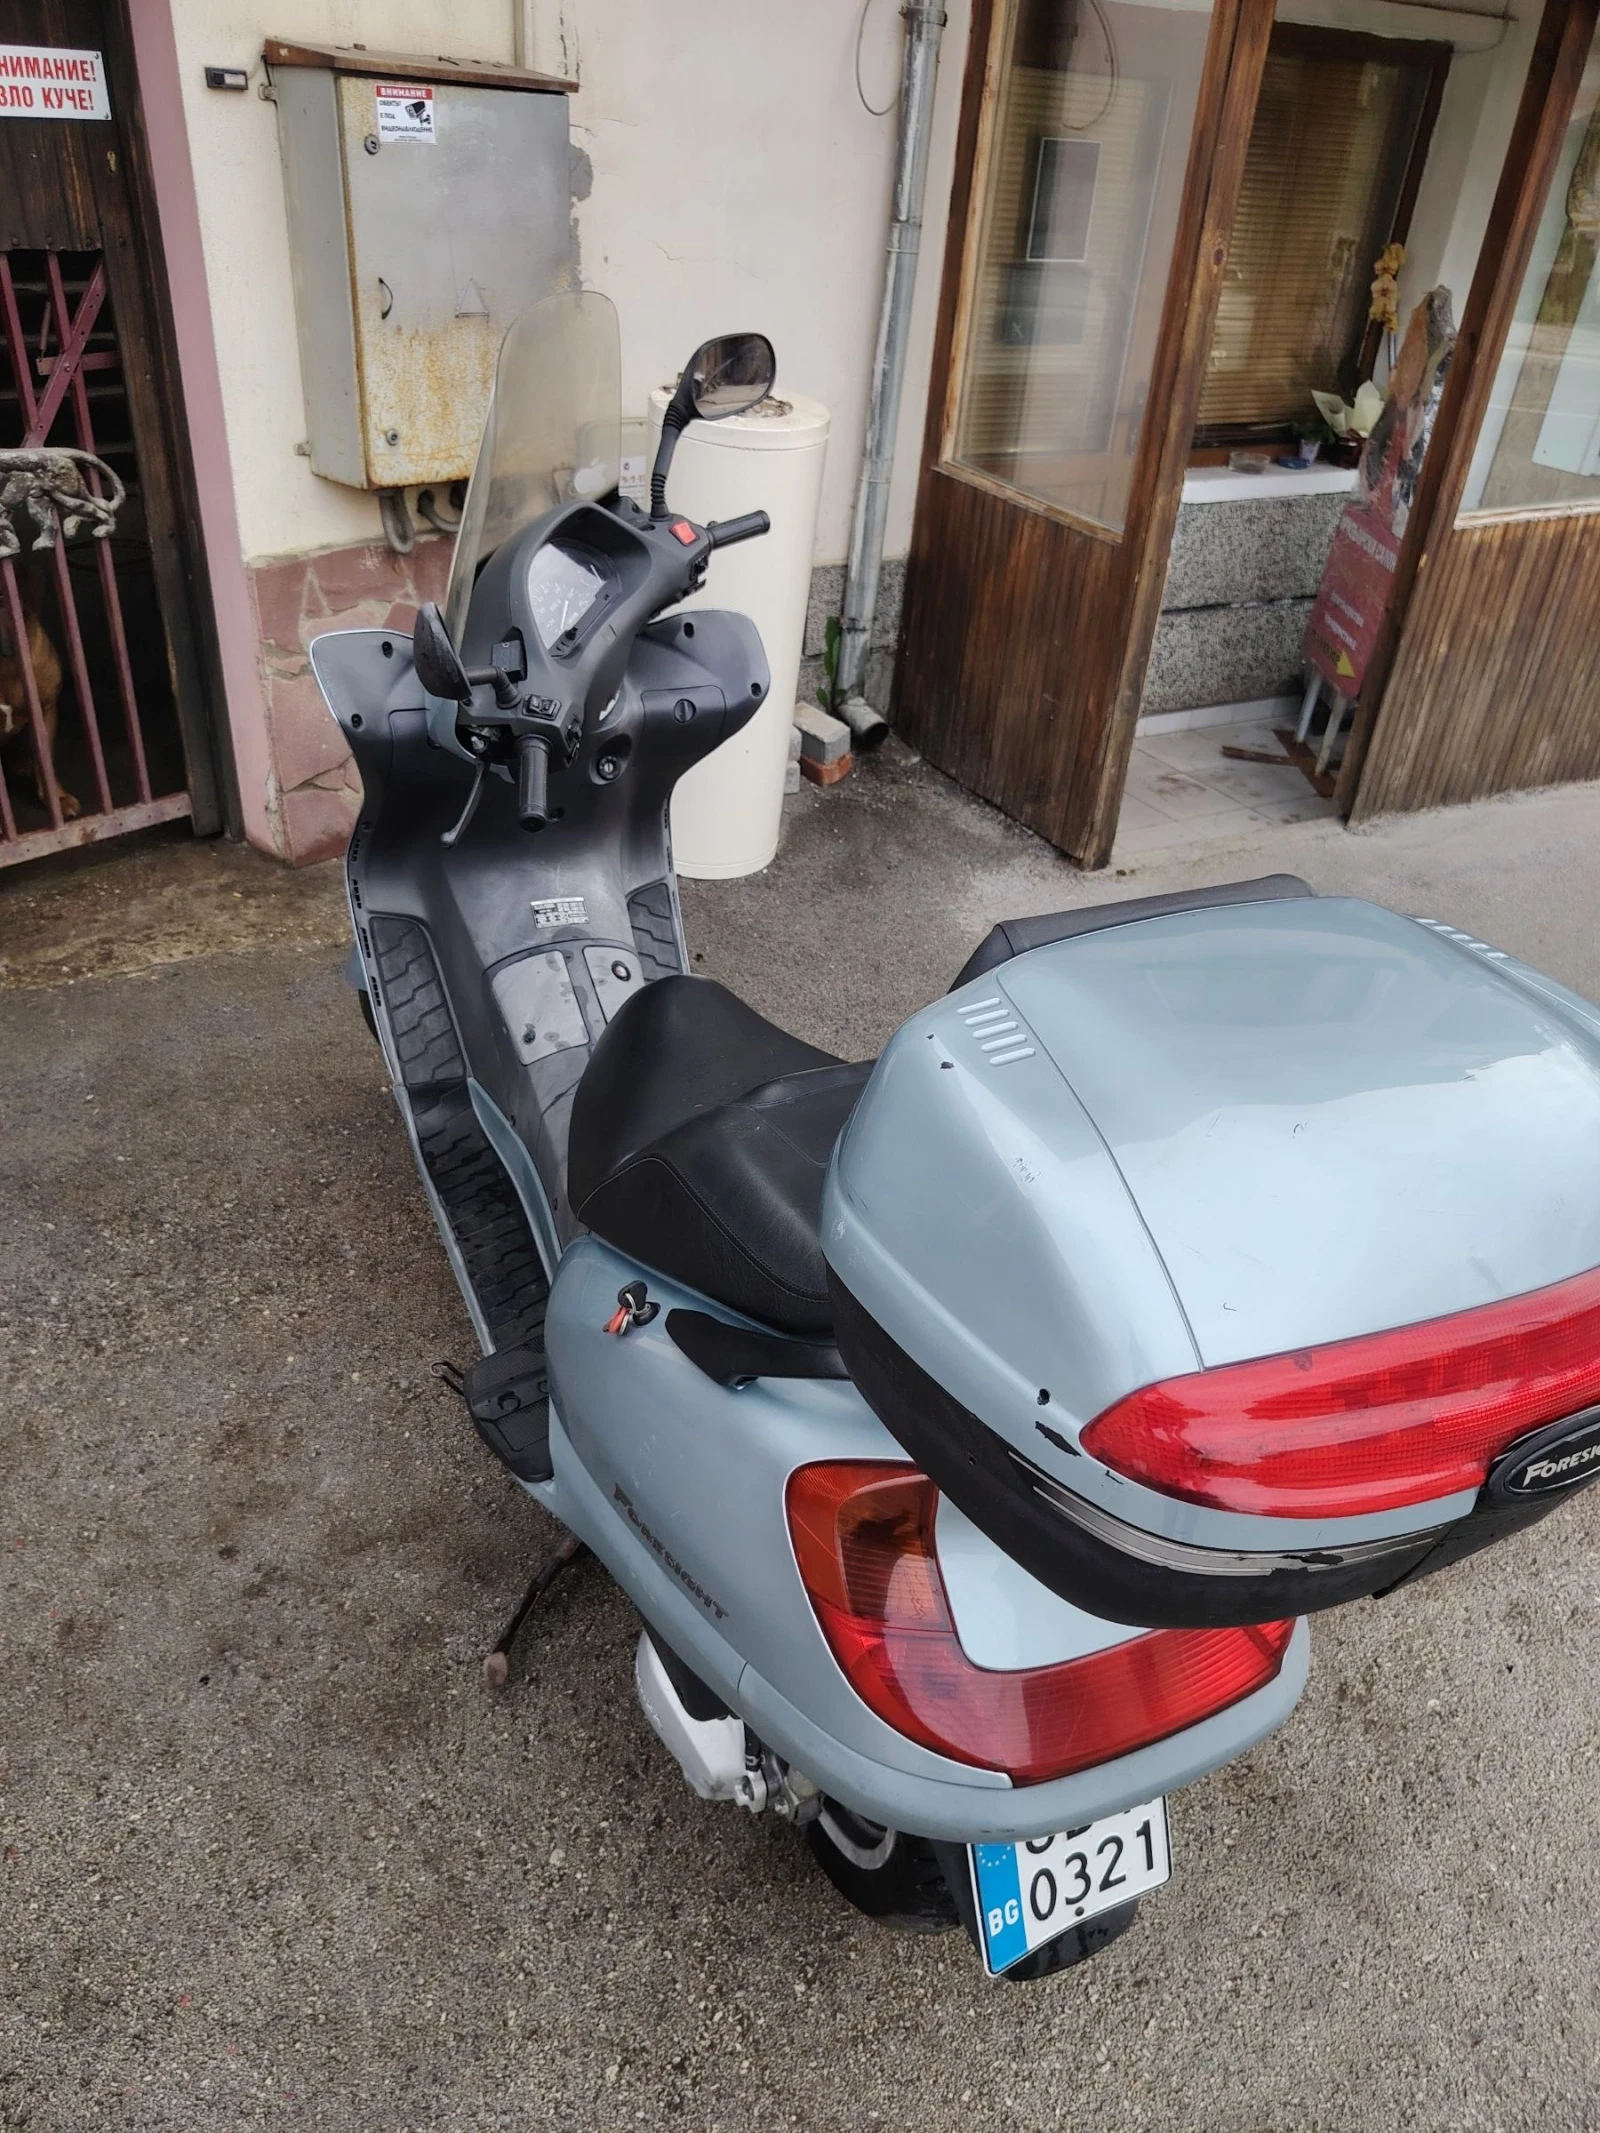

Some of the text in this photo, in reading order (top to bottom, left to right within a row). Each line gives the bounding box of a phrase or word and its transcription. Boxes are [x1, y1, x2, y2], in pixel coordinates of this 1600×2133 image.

[0, 85, 94, 111] ЗЛО КУЧЕ!
[380, 87, 427, 98] ВНИМАНИЕ
[1522, 1443, 1600, 1488] FORESI
[614, 1482, 729, 1619] FORESIGHT
[1030, 1819, 1154, 1921] 0321
[988, 1898, 1020, 1937] BG
